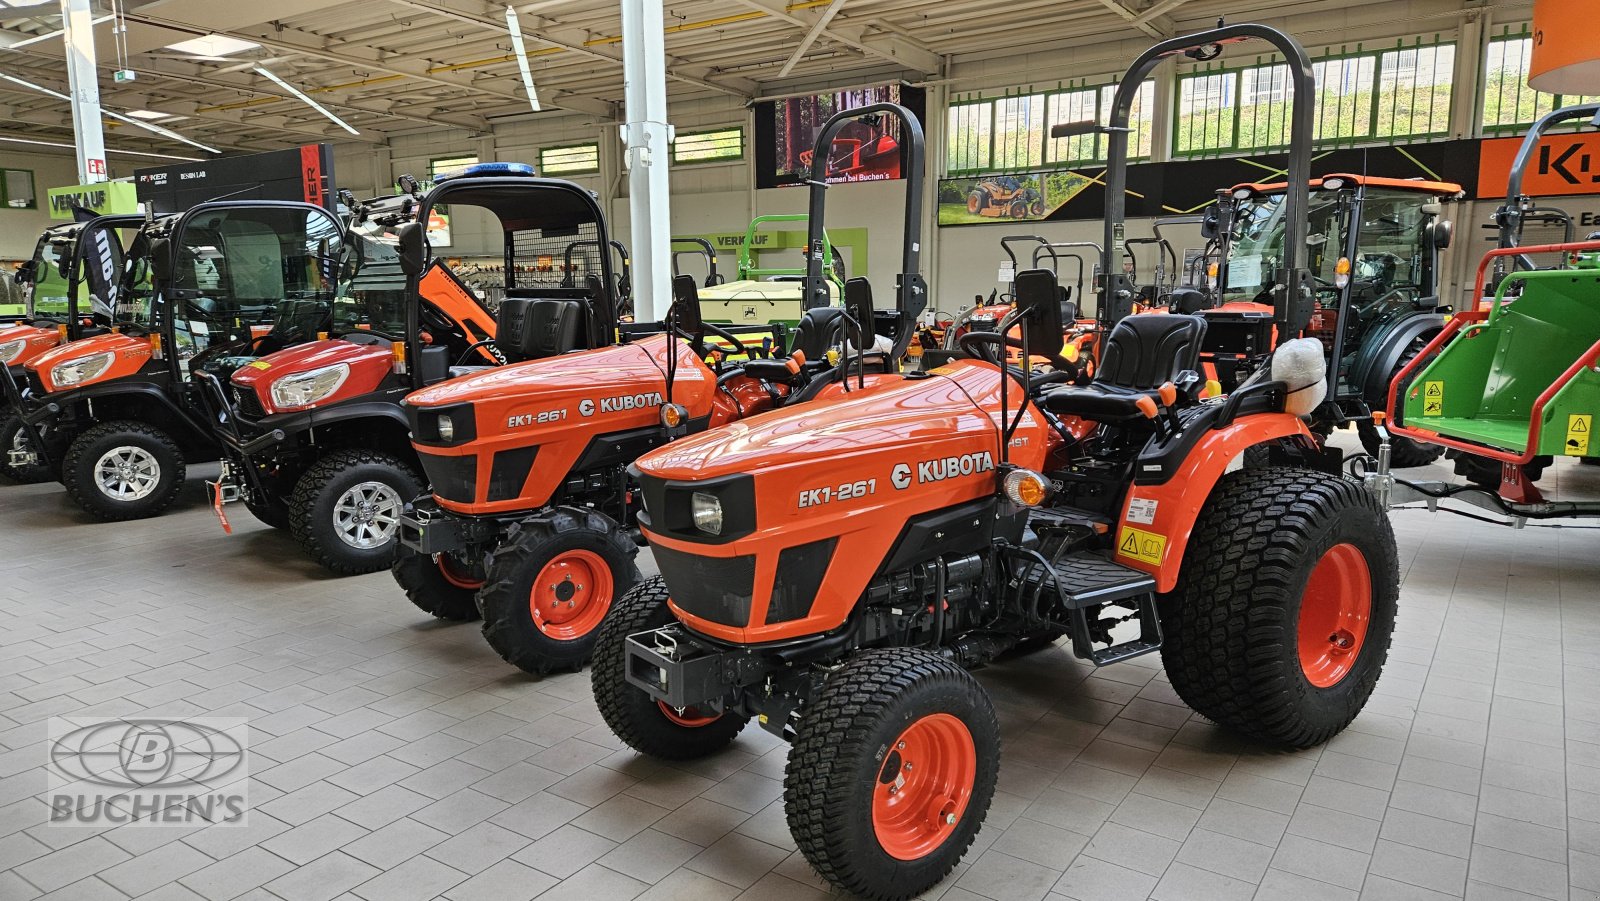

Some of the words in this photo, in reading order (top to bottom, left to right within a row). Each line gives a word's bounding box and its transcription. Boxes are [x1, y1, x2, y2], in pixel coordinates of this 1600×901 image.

[50, 190, 107, 212] VERKAUF
[507, 409, 567, 428] EK1-261
[600, 392, 663, 413] KUBOTA
[797, 478, 877, 508] EK1-261
[918, 451, 995, 484] KUBOTA
